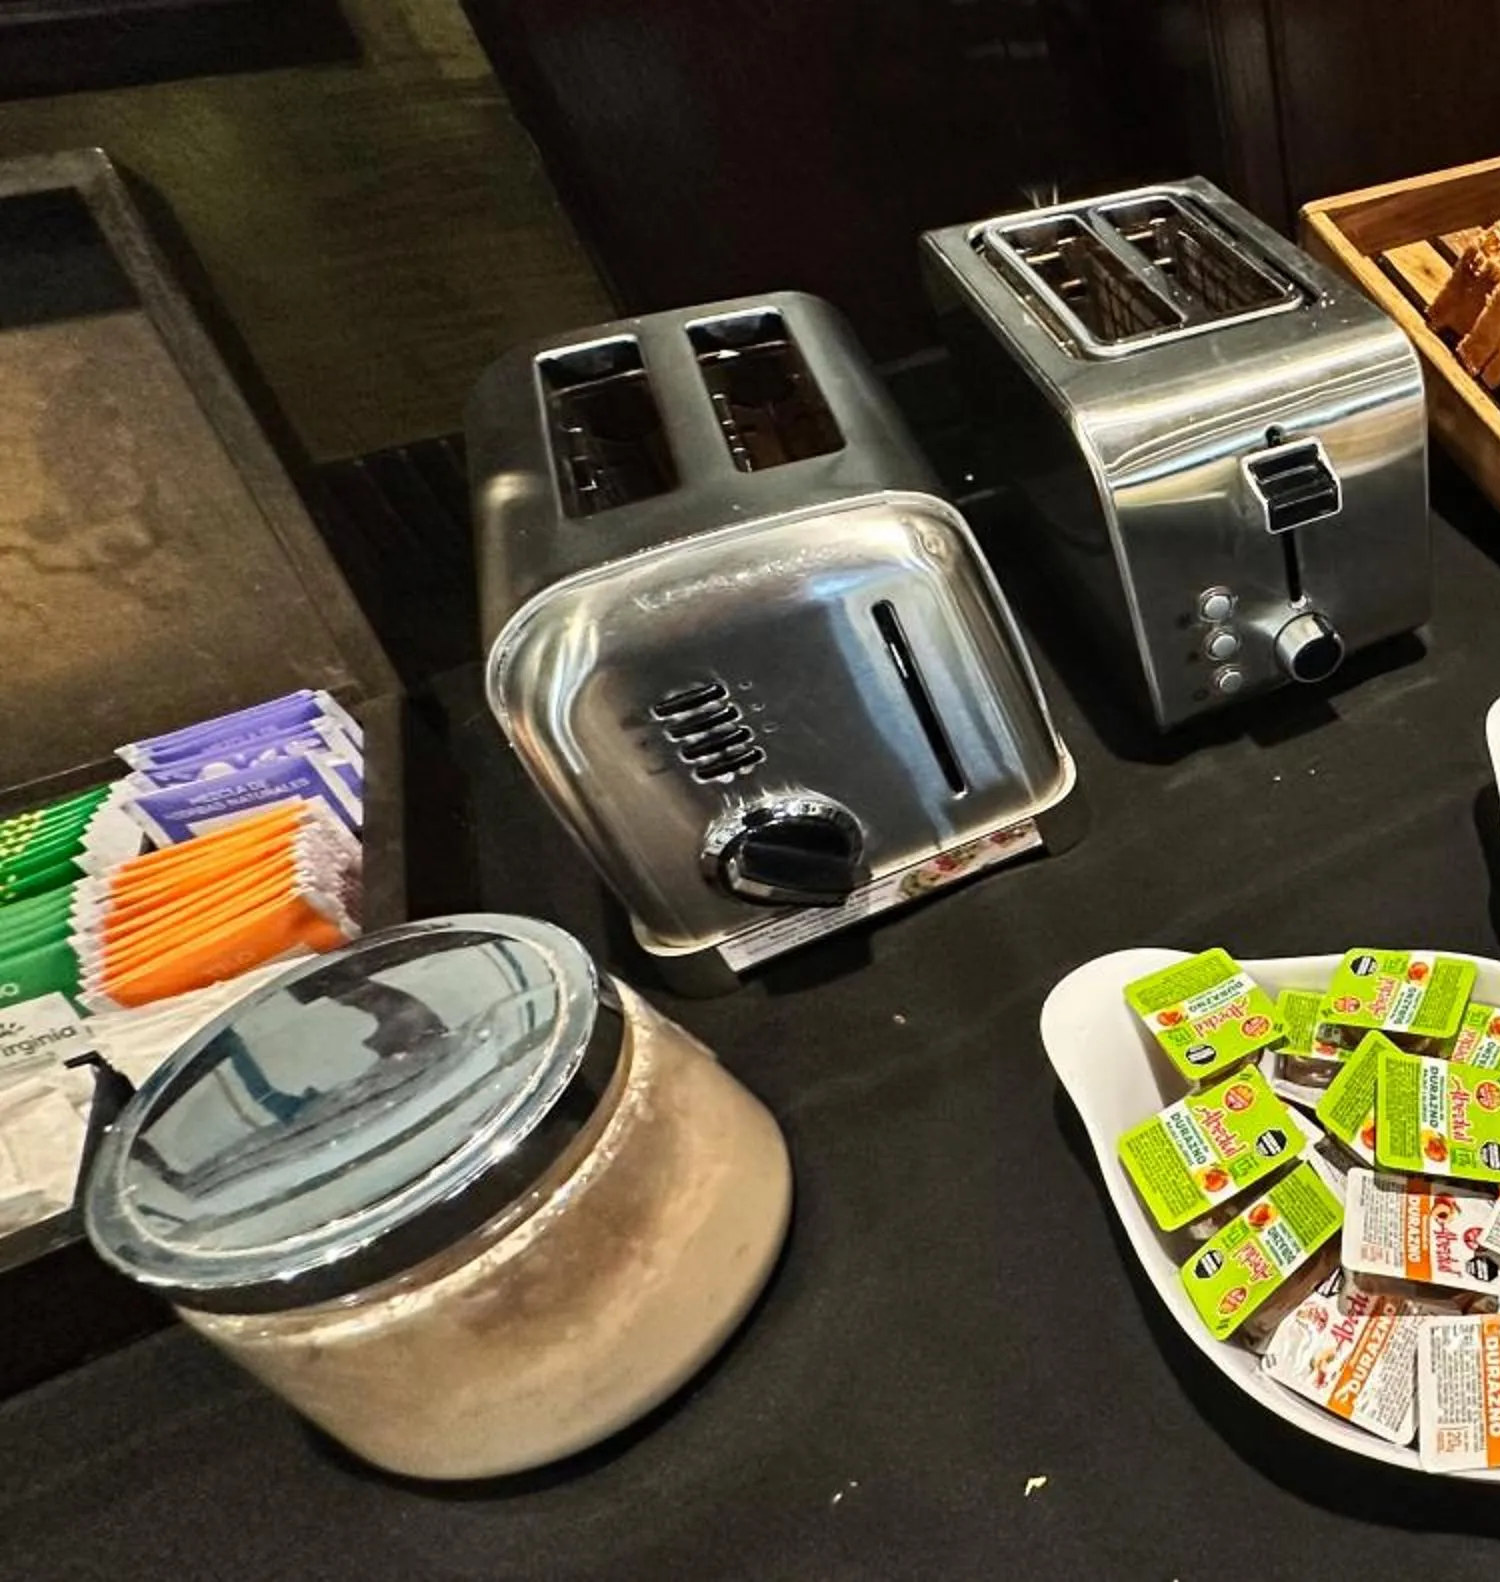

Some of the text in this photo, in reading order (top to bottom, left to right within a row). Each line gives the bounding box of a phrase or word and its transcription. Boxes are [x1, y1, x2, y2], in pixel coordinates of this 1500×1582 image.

[0, 1024, 77, 1056] irginia
[1429, 1066, 1439, 1128] DURAZNO
[1170, 1112, 1207, 1165] DURAZNO
[1407, 1196, 1421, 1263] DURAZNO
[1434, 1218, 1463, 1278] Abedul
[1328, 1291, 1368, 1349] Abed
[1350, 1304, 1397, 1391] DURAZNO
